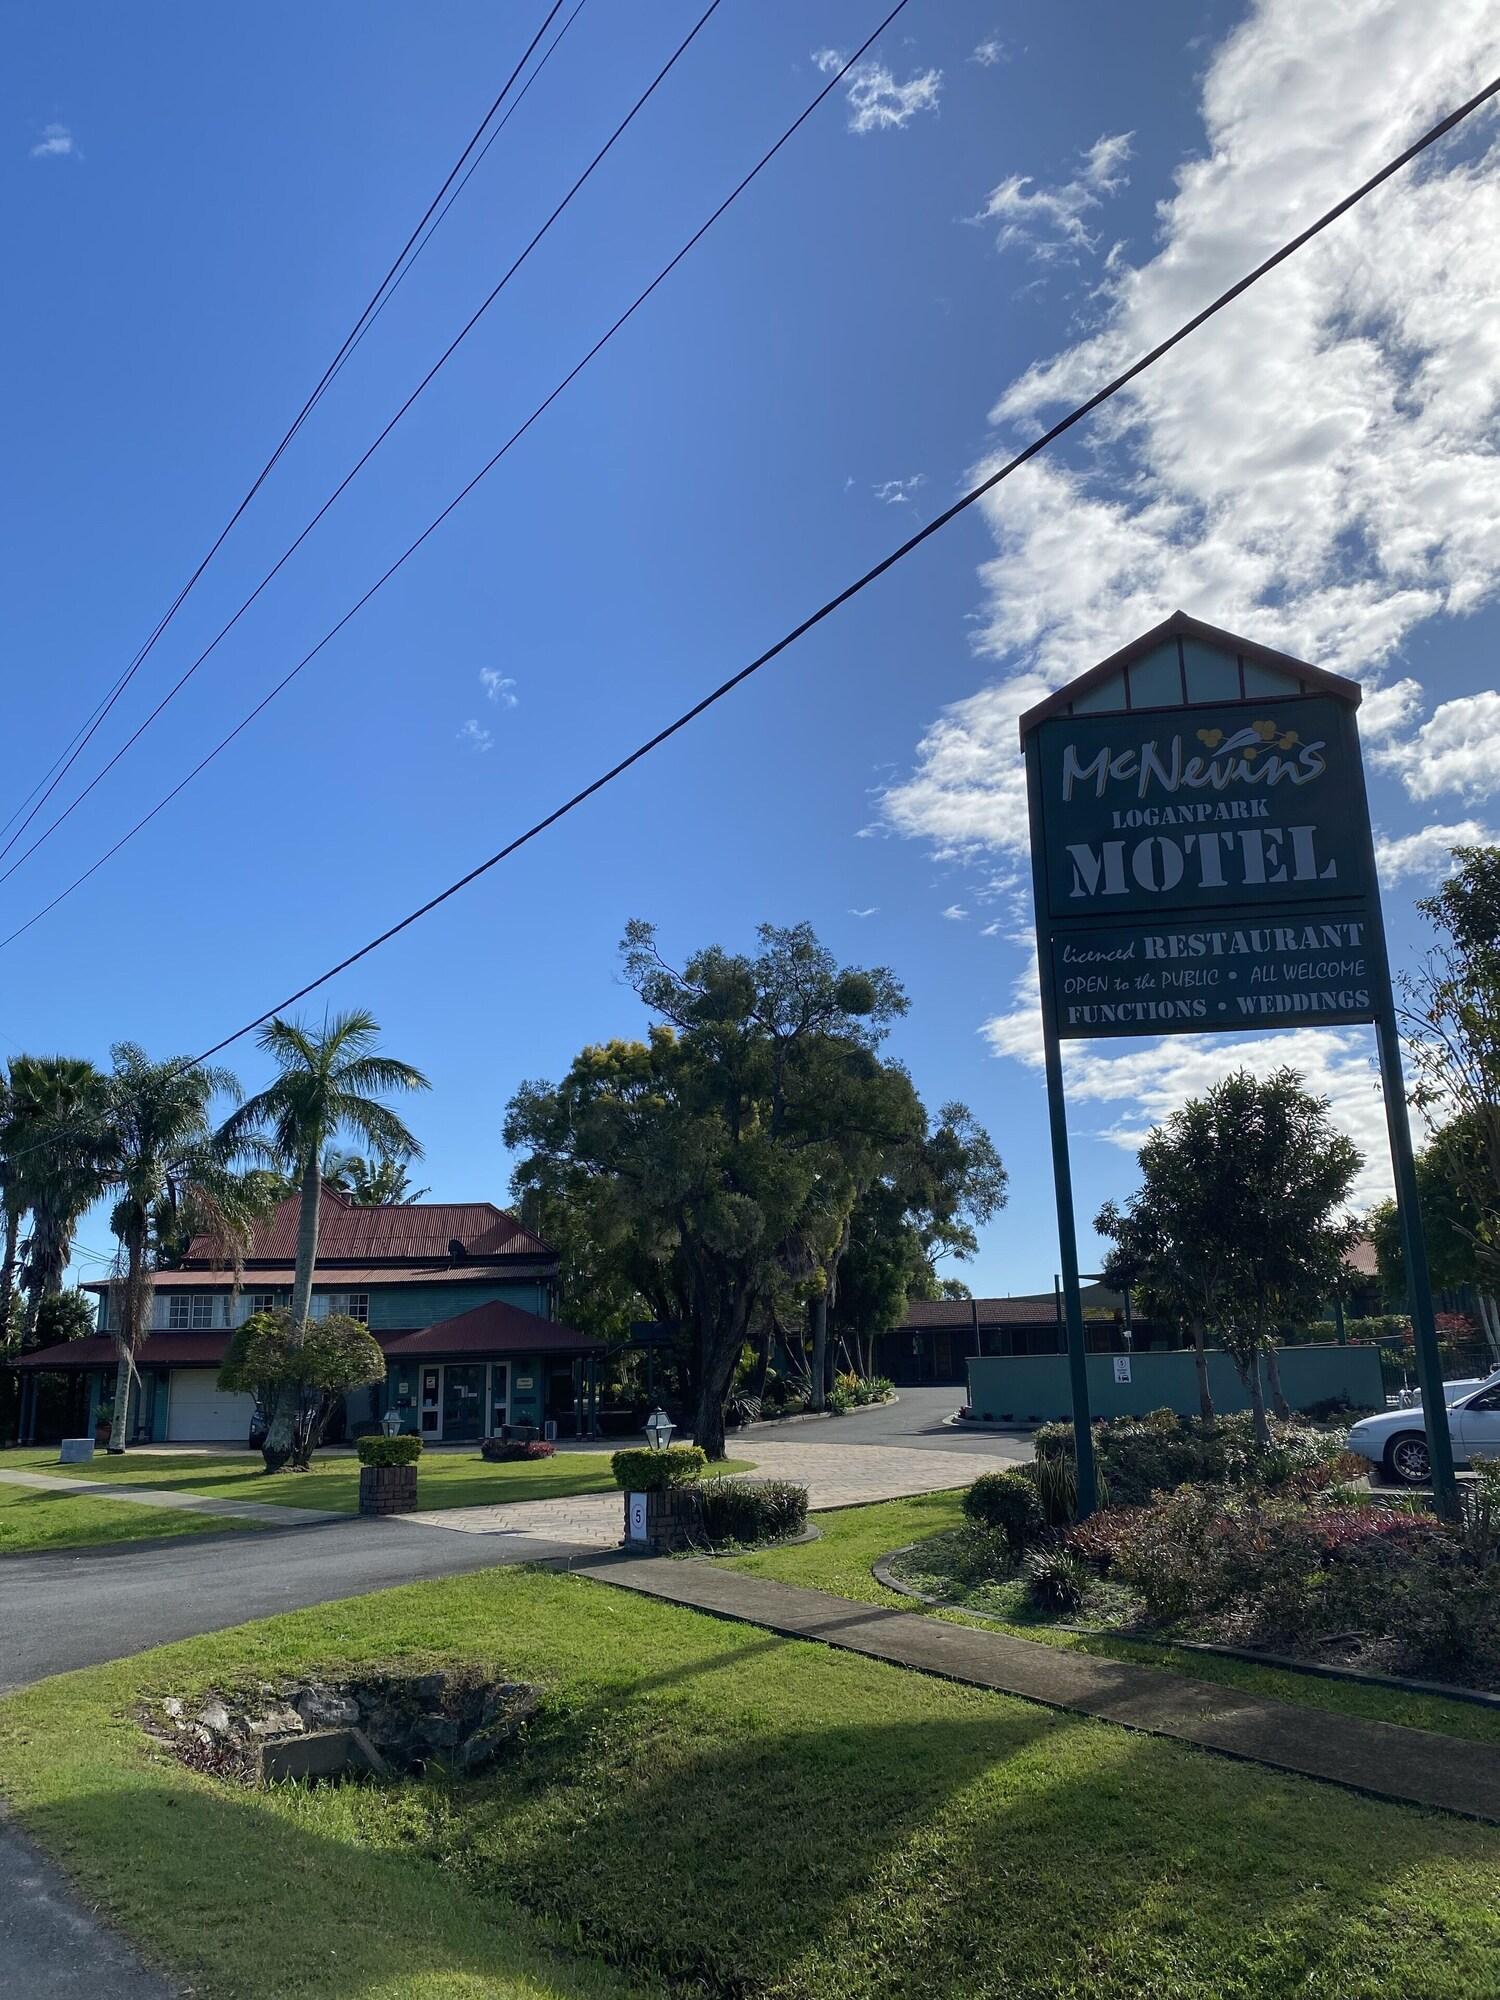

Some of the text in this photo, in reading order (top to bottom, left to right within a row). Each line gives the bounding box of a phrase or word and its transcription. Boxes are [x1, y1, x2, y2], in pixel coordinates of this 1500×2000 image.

[1062, 735, 1326, 801] McNevins
[1065, 825, 1337, 898] MOTEL
[1062, 923, 1364, 963] licenced RESTAURANT
[1064, 959, 1366, 994] OPEN to the PUBLIC ALL WELCOME
[1067, 989, 1370, 1024] FUNCTIONS WEDDINGS
[635, 1509, 641, 1524] 5
